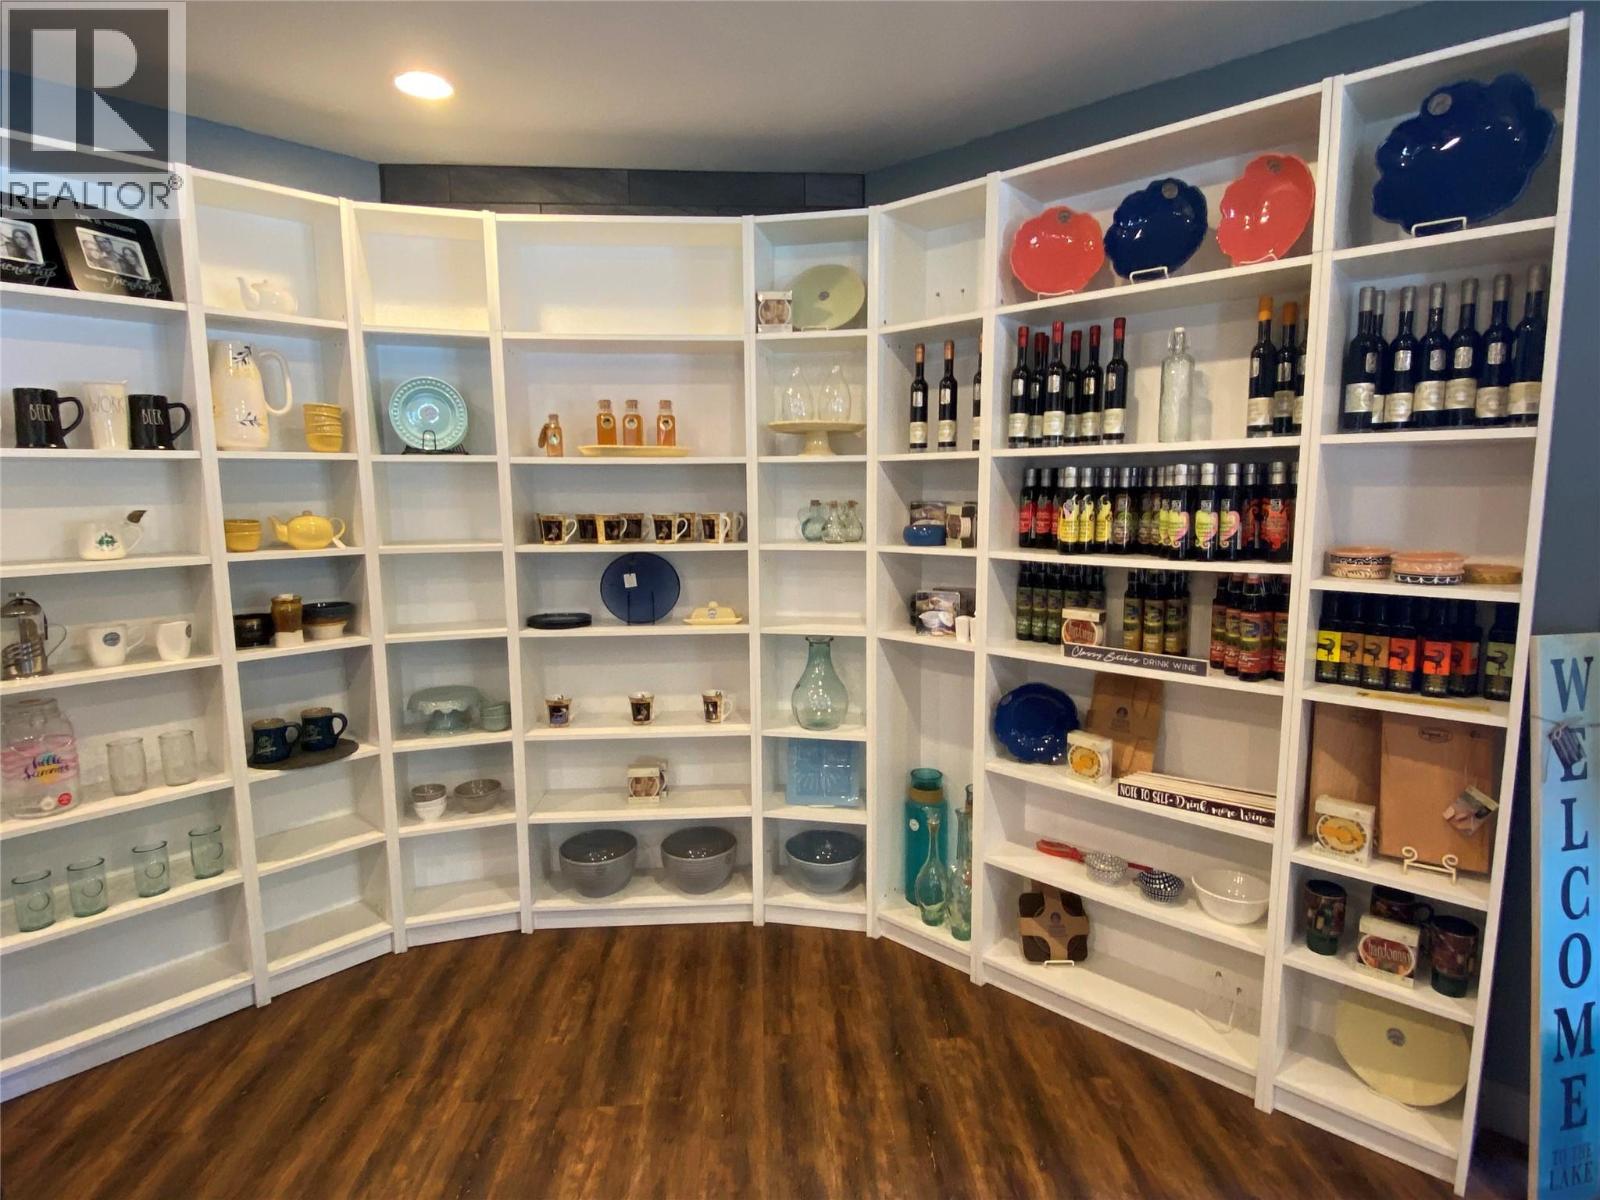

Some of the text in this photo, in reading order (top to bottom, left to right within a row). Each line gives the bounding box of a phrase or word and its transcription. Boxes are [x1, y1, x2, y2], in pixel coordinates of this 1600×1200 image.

[29, 403, 54, 422] BEER
[141, 409, 165, 425] BEER
[1142, 657, 1170, 669] DRINK
[1172, 662, 1197, 673] WINE
[1119, 784, 1137, 799] NOTE
[1140, 788, 1150, 801] TO
[1174, 794, 1209, 814] Drink
[1211, 806, 1238, 819] more
[1549, 1161, 1593, 1192] LAKE
